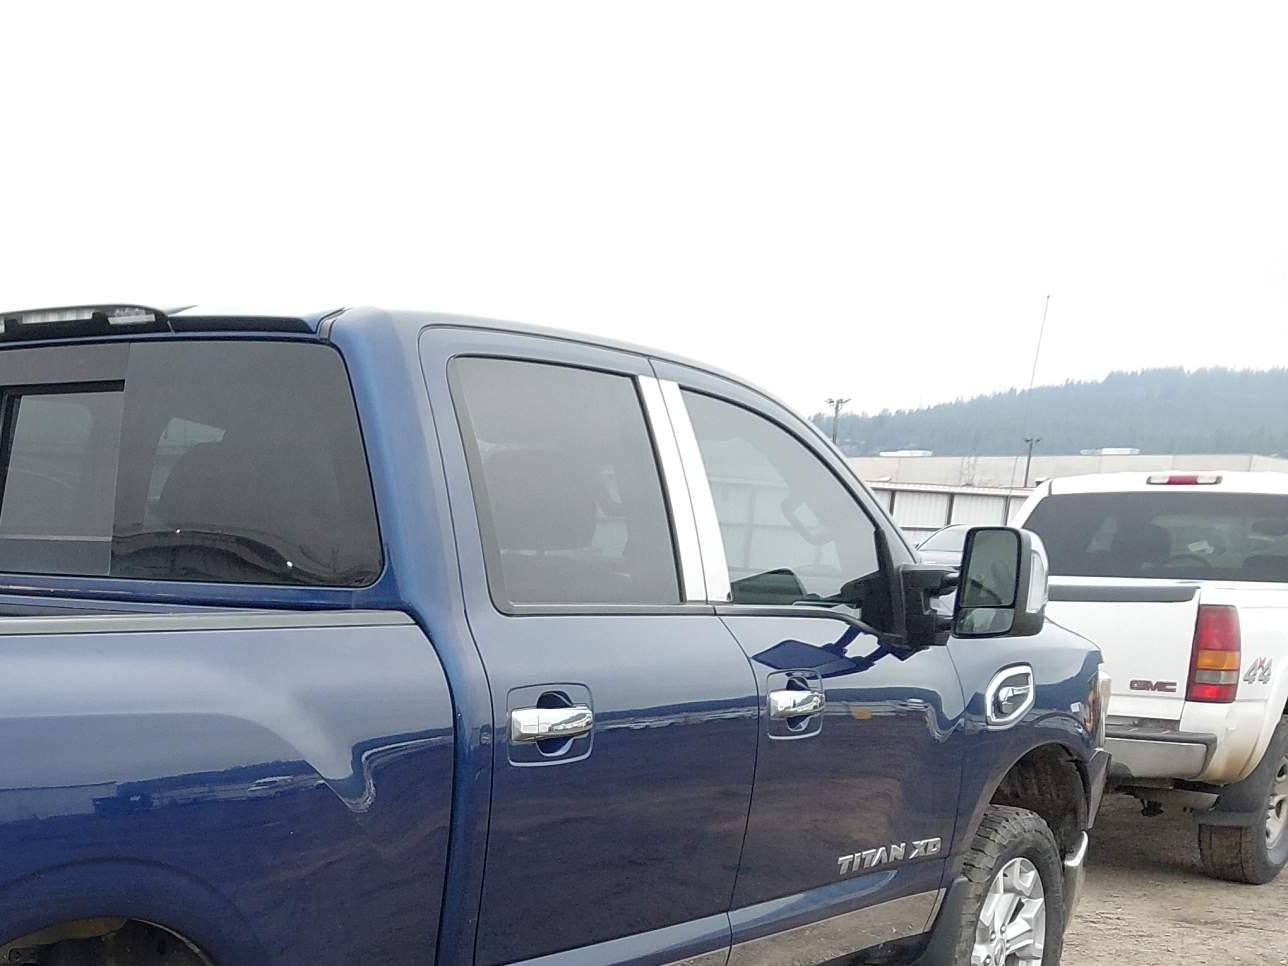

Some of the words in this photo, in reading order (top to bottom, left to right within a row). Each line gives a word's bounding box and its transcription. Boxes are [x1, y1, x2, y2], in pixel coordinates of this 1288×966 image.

[1129, 679, 1177, 693] GMC
[837, 842, 906, 875] TITAN
[909, 837, 941, 859] XD
